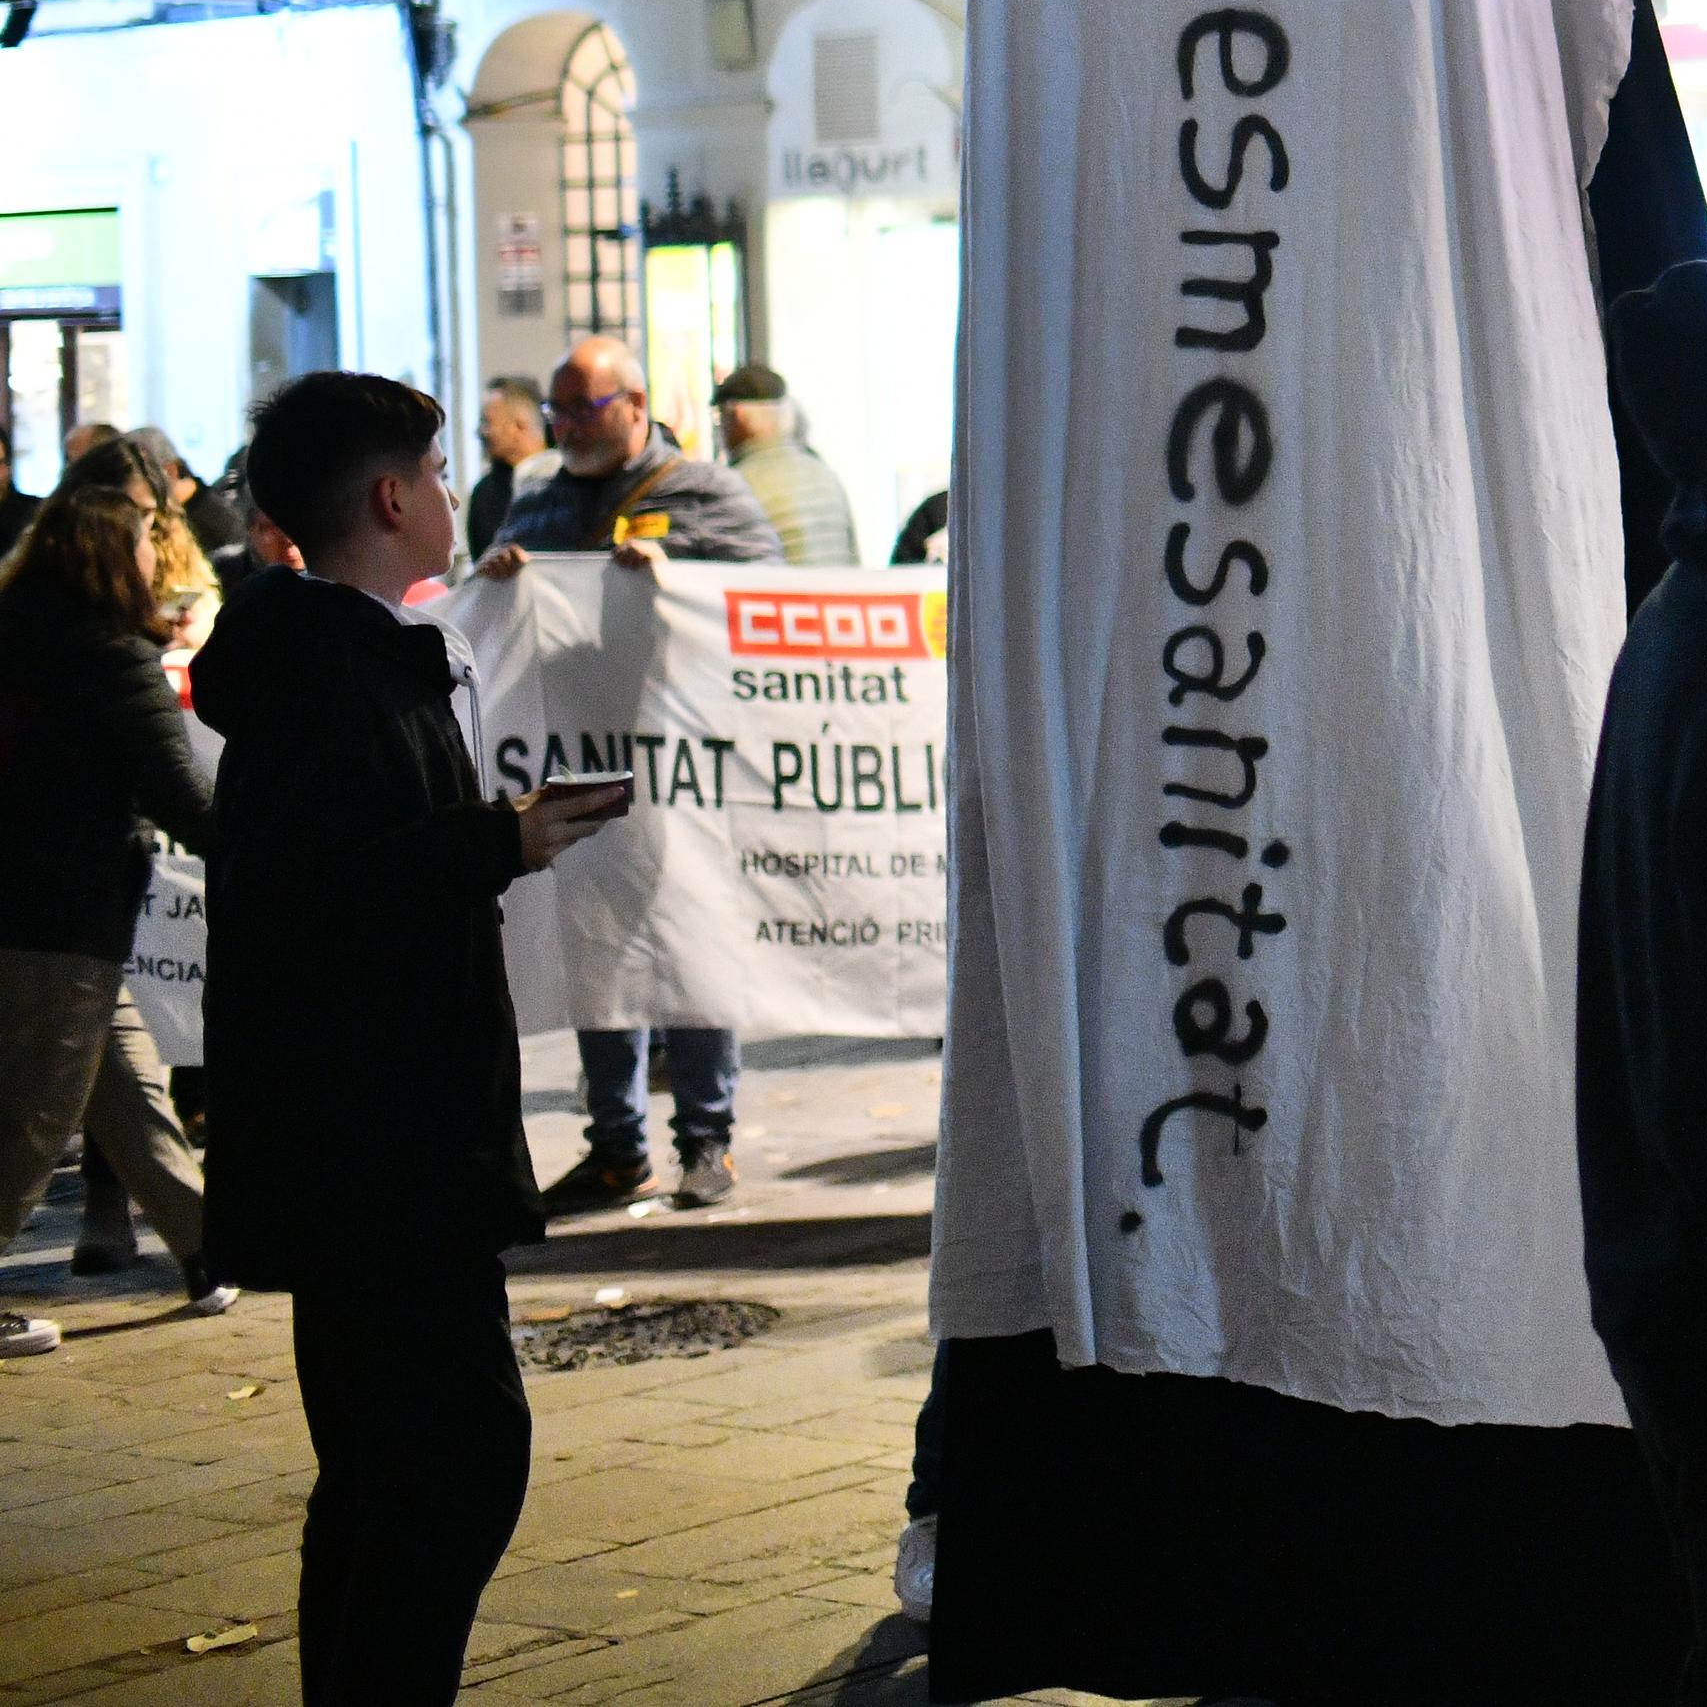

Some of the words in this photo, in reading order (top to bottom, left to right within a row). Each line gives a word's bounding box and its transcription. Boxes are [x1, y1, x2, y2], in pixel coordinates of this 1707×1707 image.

[738, 599, 909, 646] CCOO
[732, 662, 909, 704] sanitat
[495, 731, 736, 811] SANITAT
[771, 723, 947, 814] PÚBLI
[741, 850, 878, 879] HOSPITAL
[890, 852, 927, 878] DE
[755, 915, 881, 946] ATENCIÓ
[896, 920, 947, 945] PRI
